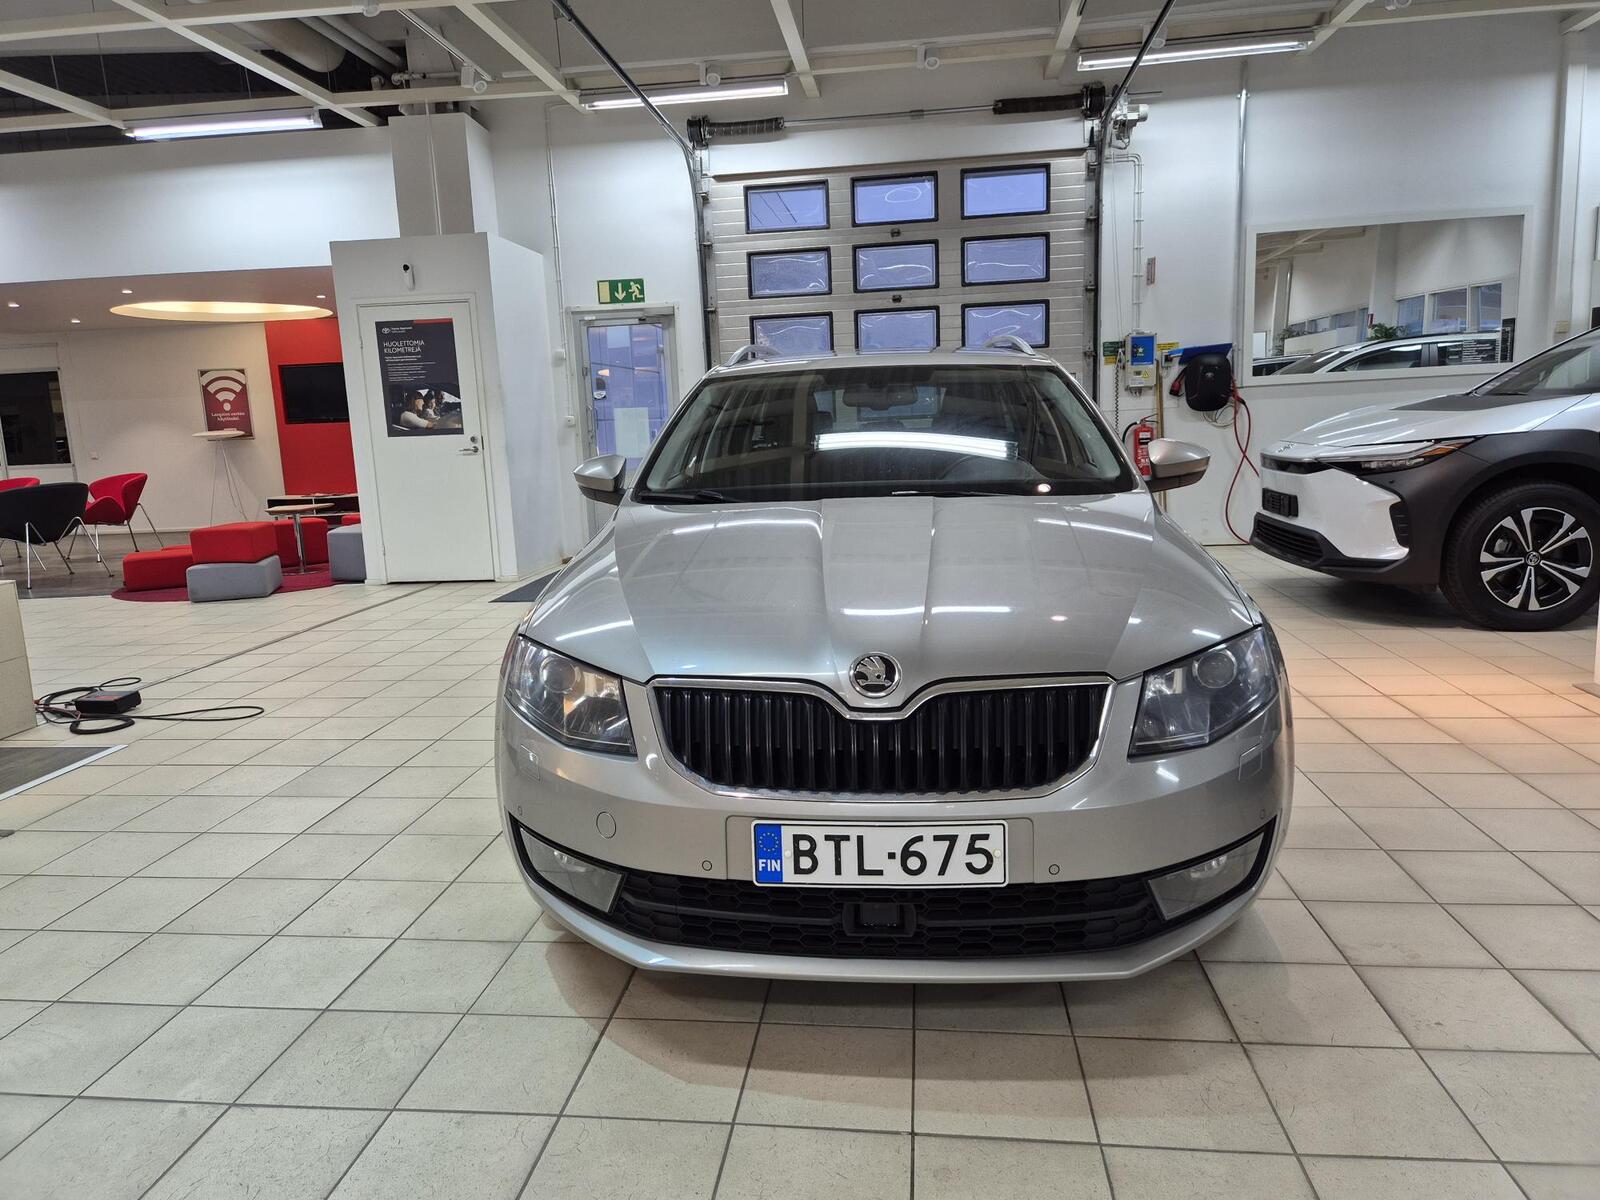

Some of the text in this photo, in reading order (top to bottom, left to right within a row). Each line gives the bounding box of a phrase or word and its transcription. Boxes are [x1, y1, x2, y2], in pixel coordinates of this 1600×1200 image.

[383, 340, 425, 348] HUOLETTOMIA
[792, 833, 994, 877] BTL-675
[758, 859, 781, 872] FIN
